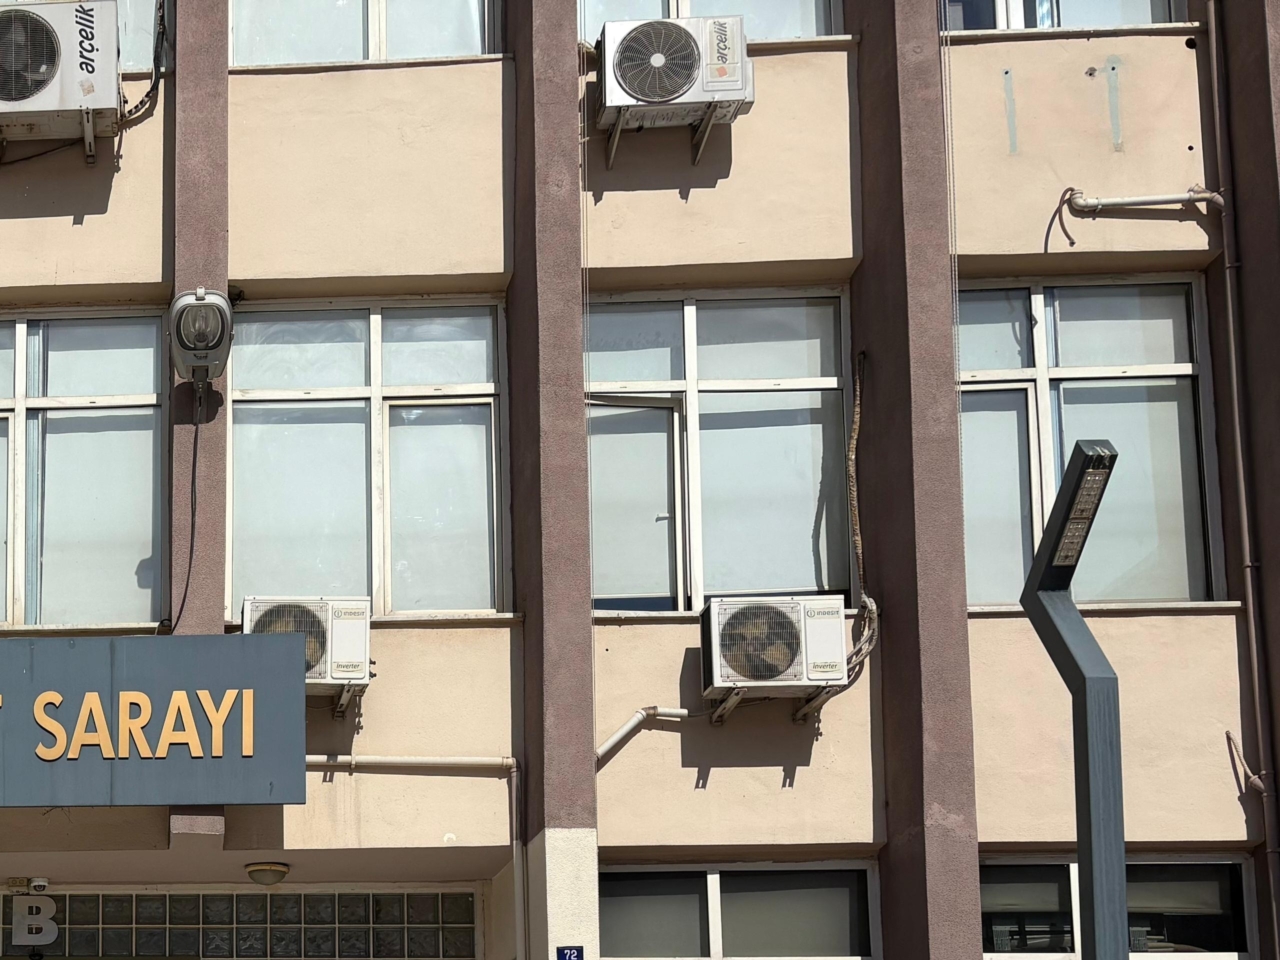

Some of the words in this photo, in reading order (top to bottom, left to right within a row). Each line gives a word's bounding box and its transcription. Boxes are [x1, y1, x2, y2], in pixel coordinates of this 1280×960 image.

[74, 4, 99, 74] arçelik
[713, 20, 730, 64] arçelik
[32, 688, 254, 761] SARAYI
[11, 895, 59, 946] B
[564, 949, 578, 960] 72
